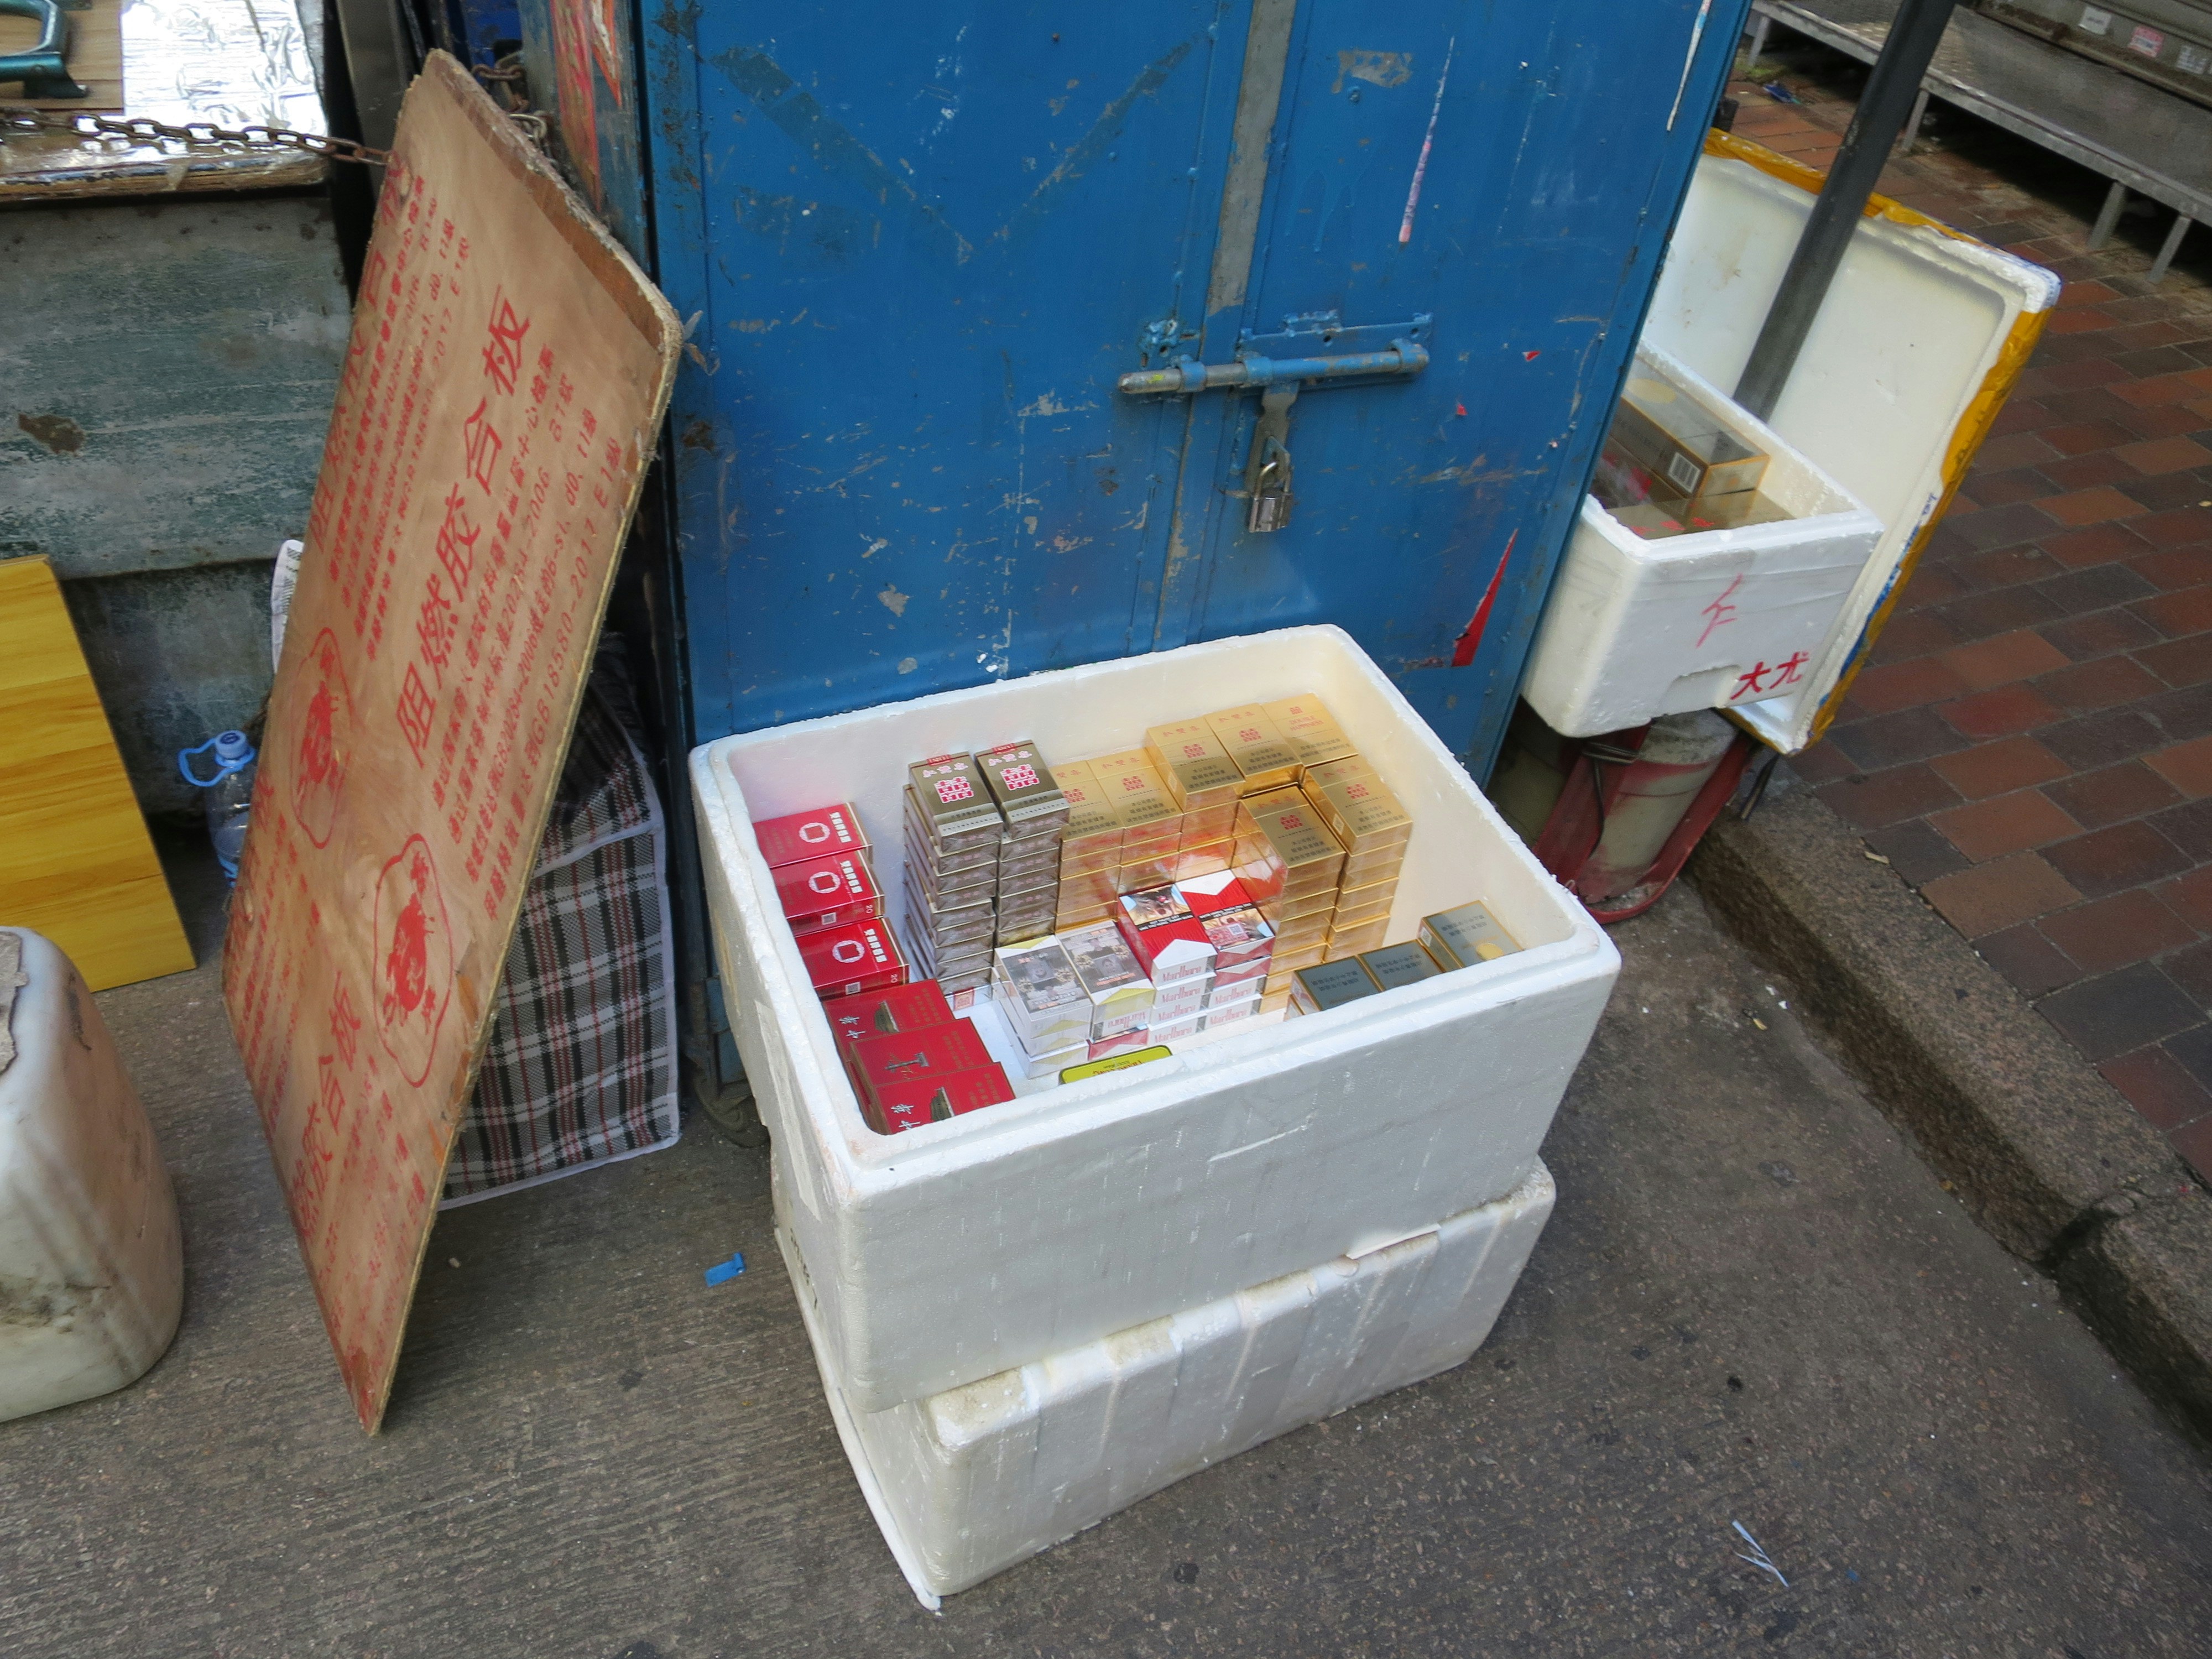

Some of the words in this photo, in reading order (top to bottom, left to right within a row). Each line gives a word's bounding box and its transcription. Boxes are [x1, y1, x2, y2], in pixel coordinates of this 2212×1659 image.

[397, 291, 530, 761] 阻燃胶合板
[890, 974, 899, 984] 20
[1163, 966, 1201, 982] Marlboro
[1162, 987, 1201, 1003] Marlboro
[1215, 988, 1252, 1004] Marlboro
[1159, 1005, 1196, 1021] Marlboro
[1209, 1009, 1248, 1024] Marlboro
[1155, 1026, 1192, 1044] Marlboro
